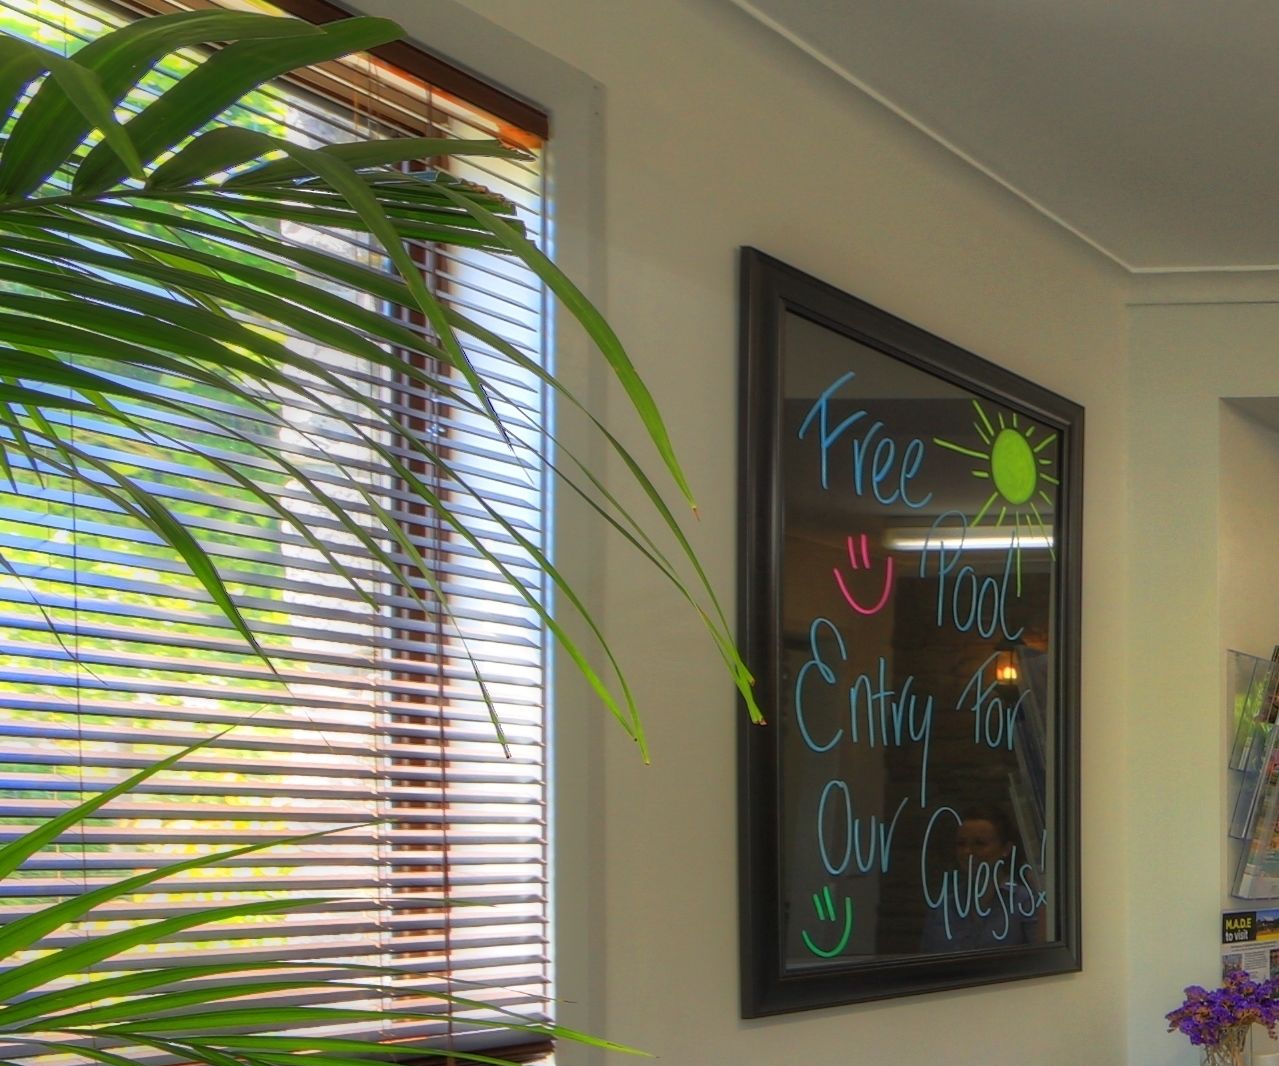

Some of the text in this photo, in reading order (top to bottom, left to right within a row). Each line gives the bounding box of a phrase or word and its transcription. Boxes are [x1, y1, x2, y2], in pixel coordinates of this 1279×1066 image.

[799, 372, 932, 508] Free
[919, 510, 1025, 642] Pool
[795, 616, 1031, 807] Entry For
[817, 779, 909, 876] Our
[920, 805, 1048, 940] Guests!
[1225, 929, 1249, 942] to visit
